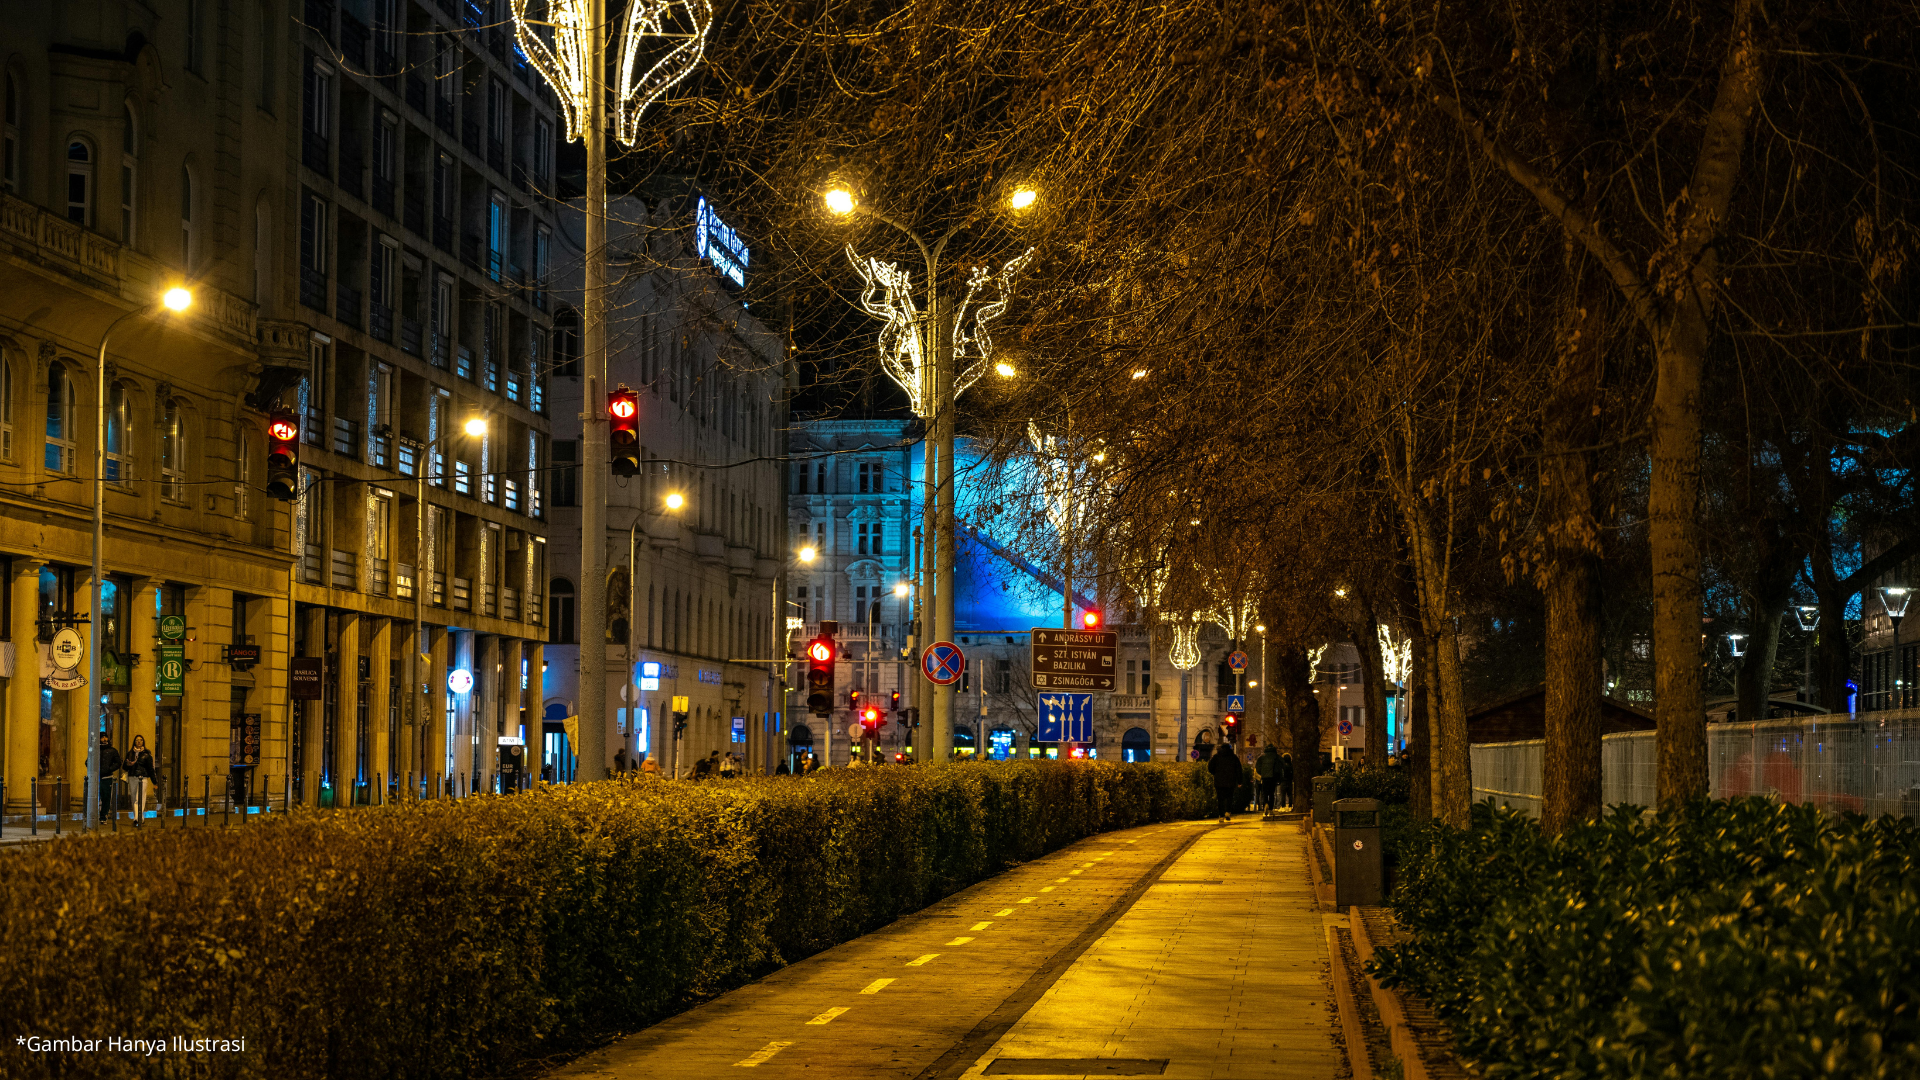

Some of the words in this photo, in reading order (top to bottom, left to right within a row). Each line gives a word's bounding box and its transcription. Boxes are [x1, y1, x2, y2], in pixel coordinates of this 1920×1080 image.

[1054, 632, 1093, 643] ANDRÁSSY
[1095, 633, 1106, 643] ÚT
[230, 648, 257, 656] LÁNGOS
[1071, 648, 1097, 660] ISTVÁN
[167, 662, 179, 678] R
[1053, 661, 1087, 671] BAZILIKA
[1052, 676, 1095, 686] ZSINAGÓGA
